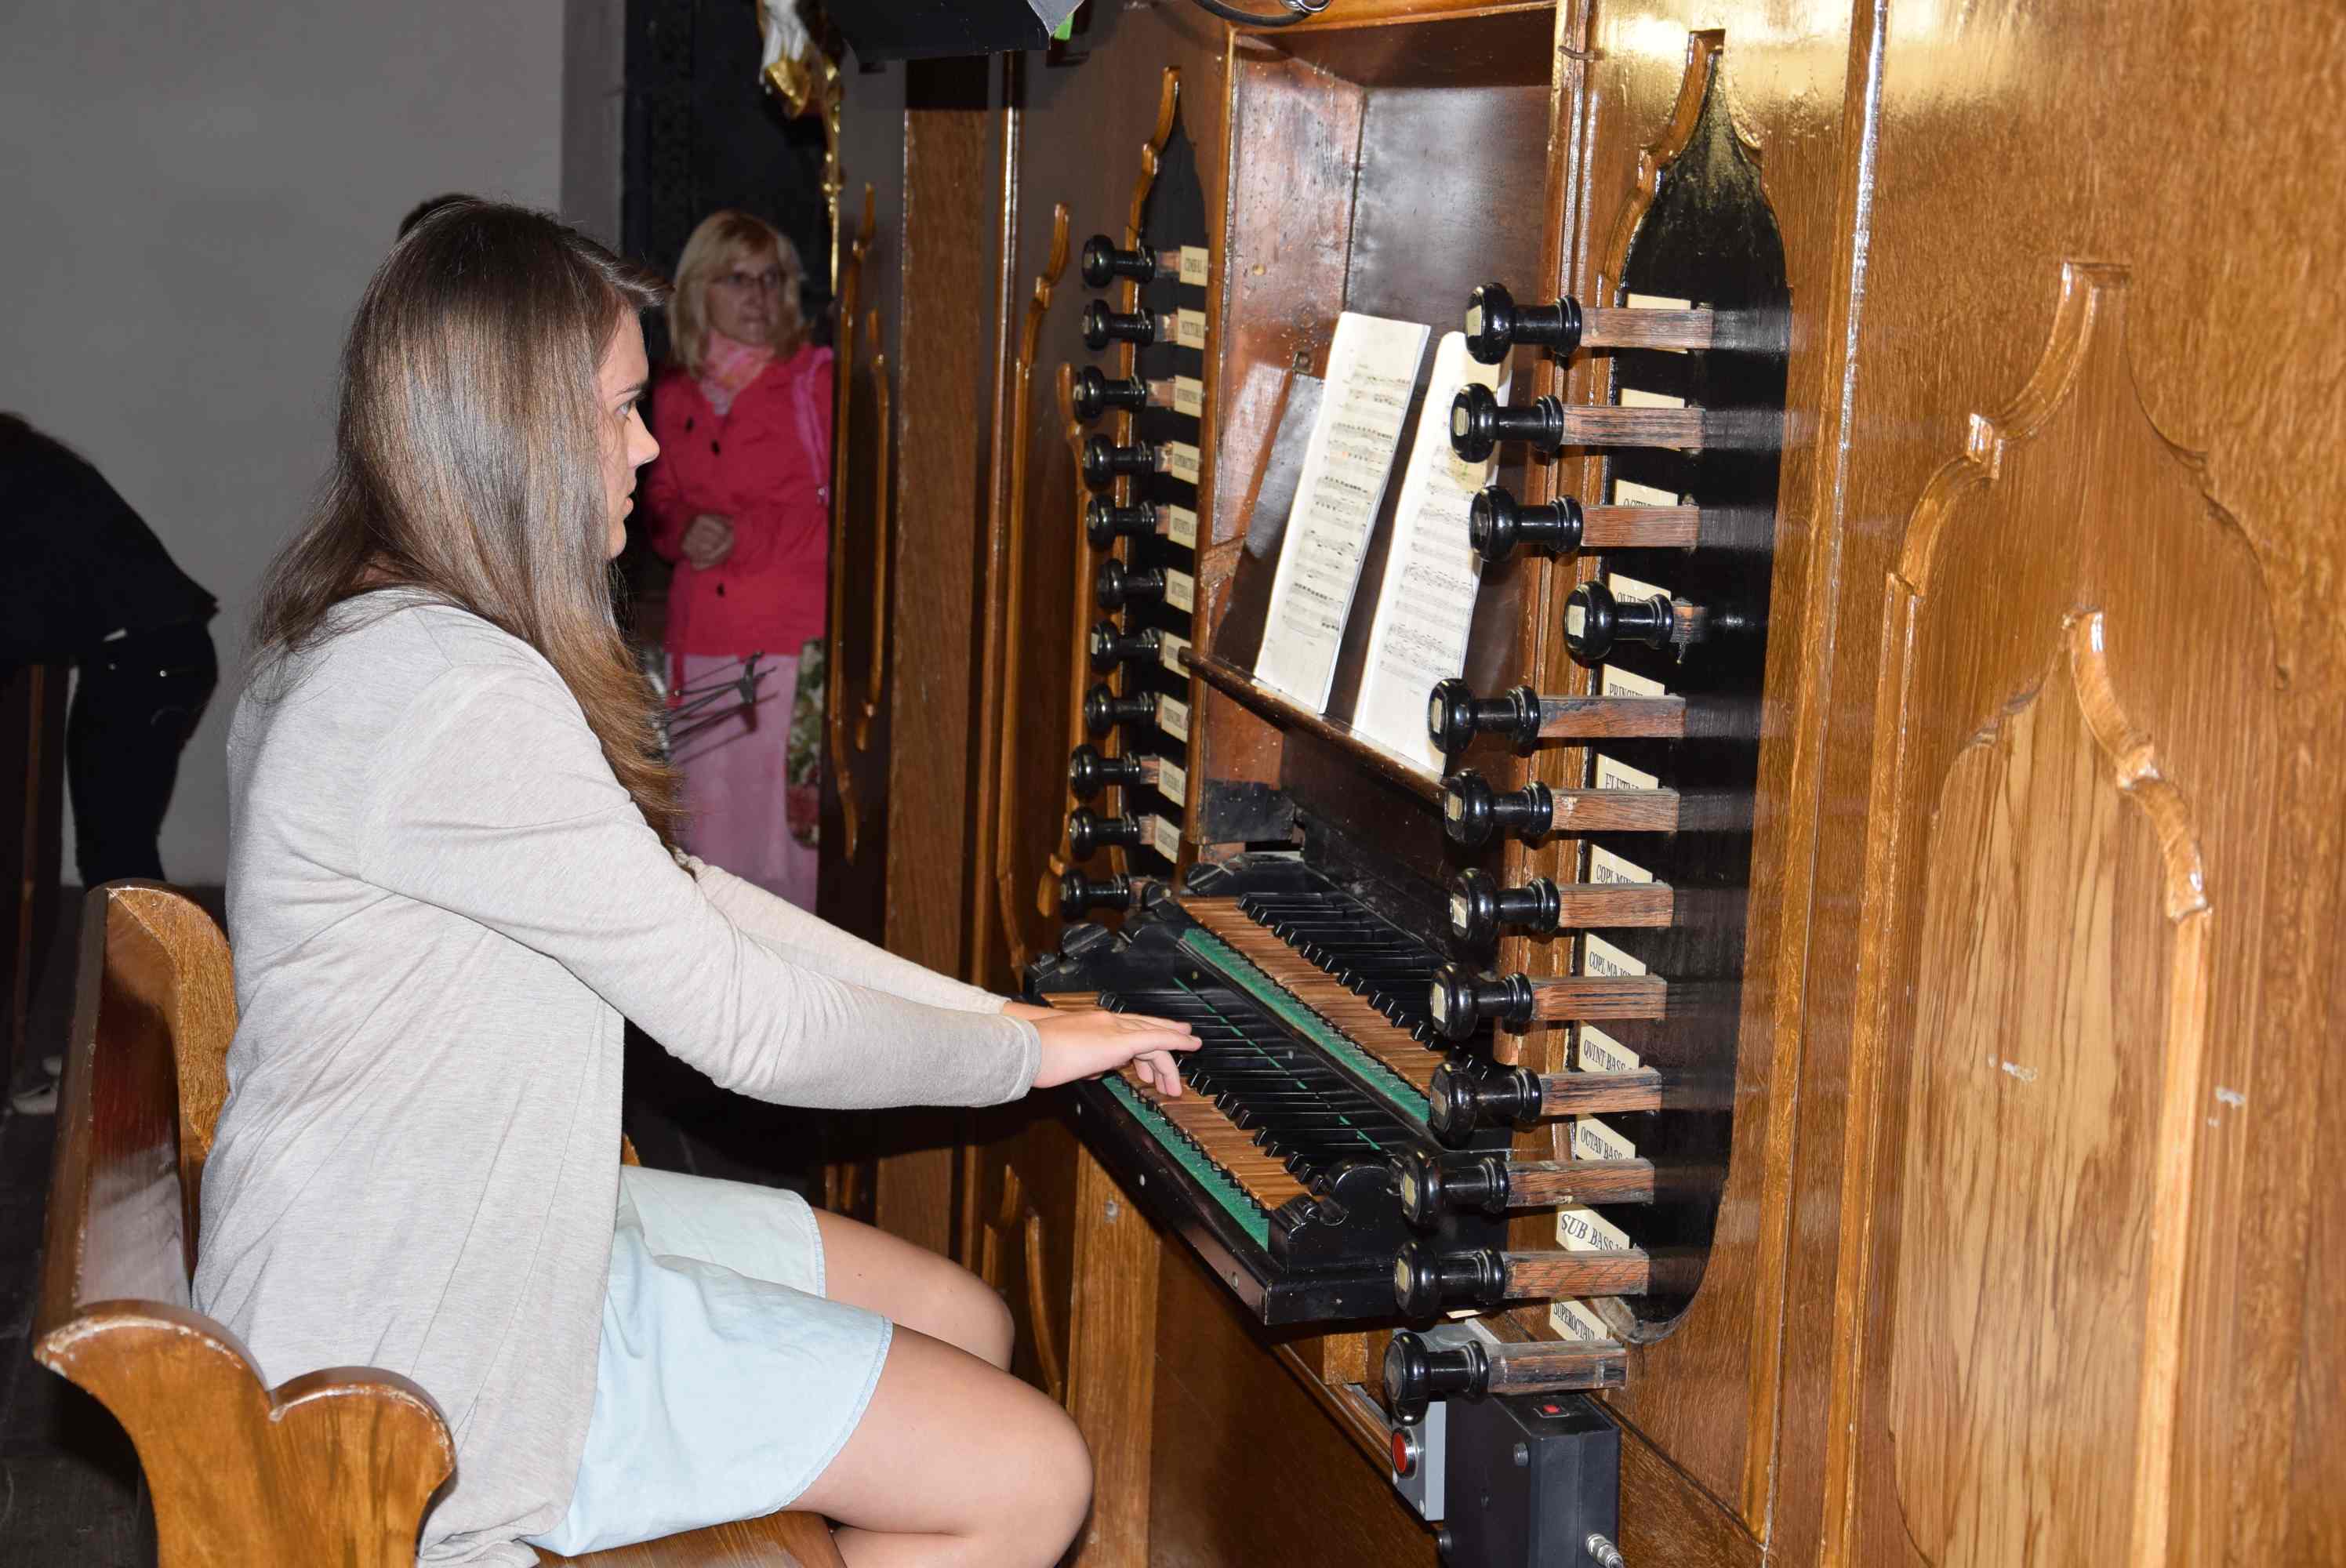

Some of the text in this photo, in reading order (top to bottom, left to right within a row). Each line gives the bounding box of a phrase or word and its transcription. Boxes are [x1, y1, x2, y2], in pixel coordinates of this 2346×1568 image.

[1584, 1040, 1606, 1067] QVINT
[1581, 1126, 1603, 1155] OCTAV
[1561, 1214, 1589, 1240] SUB
